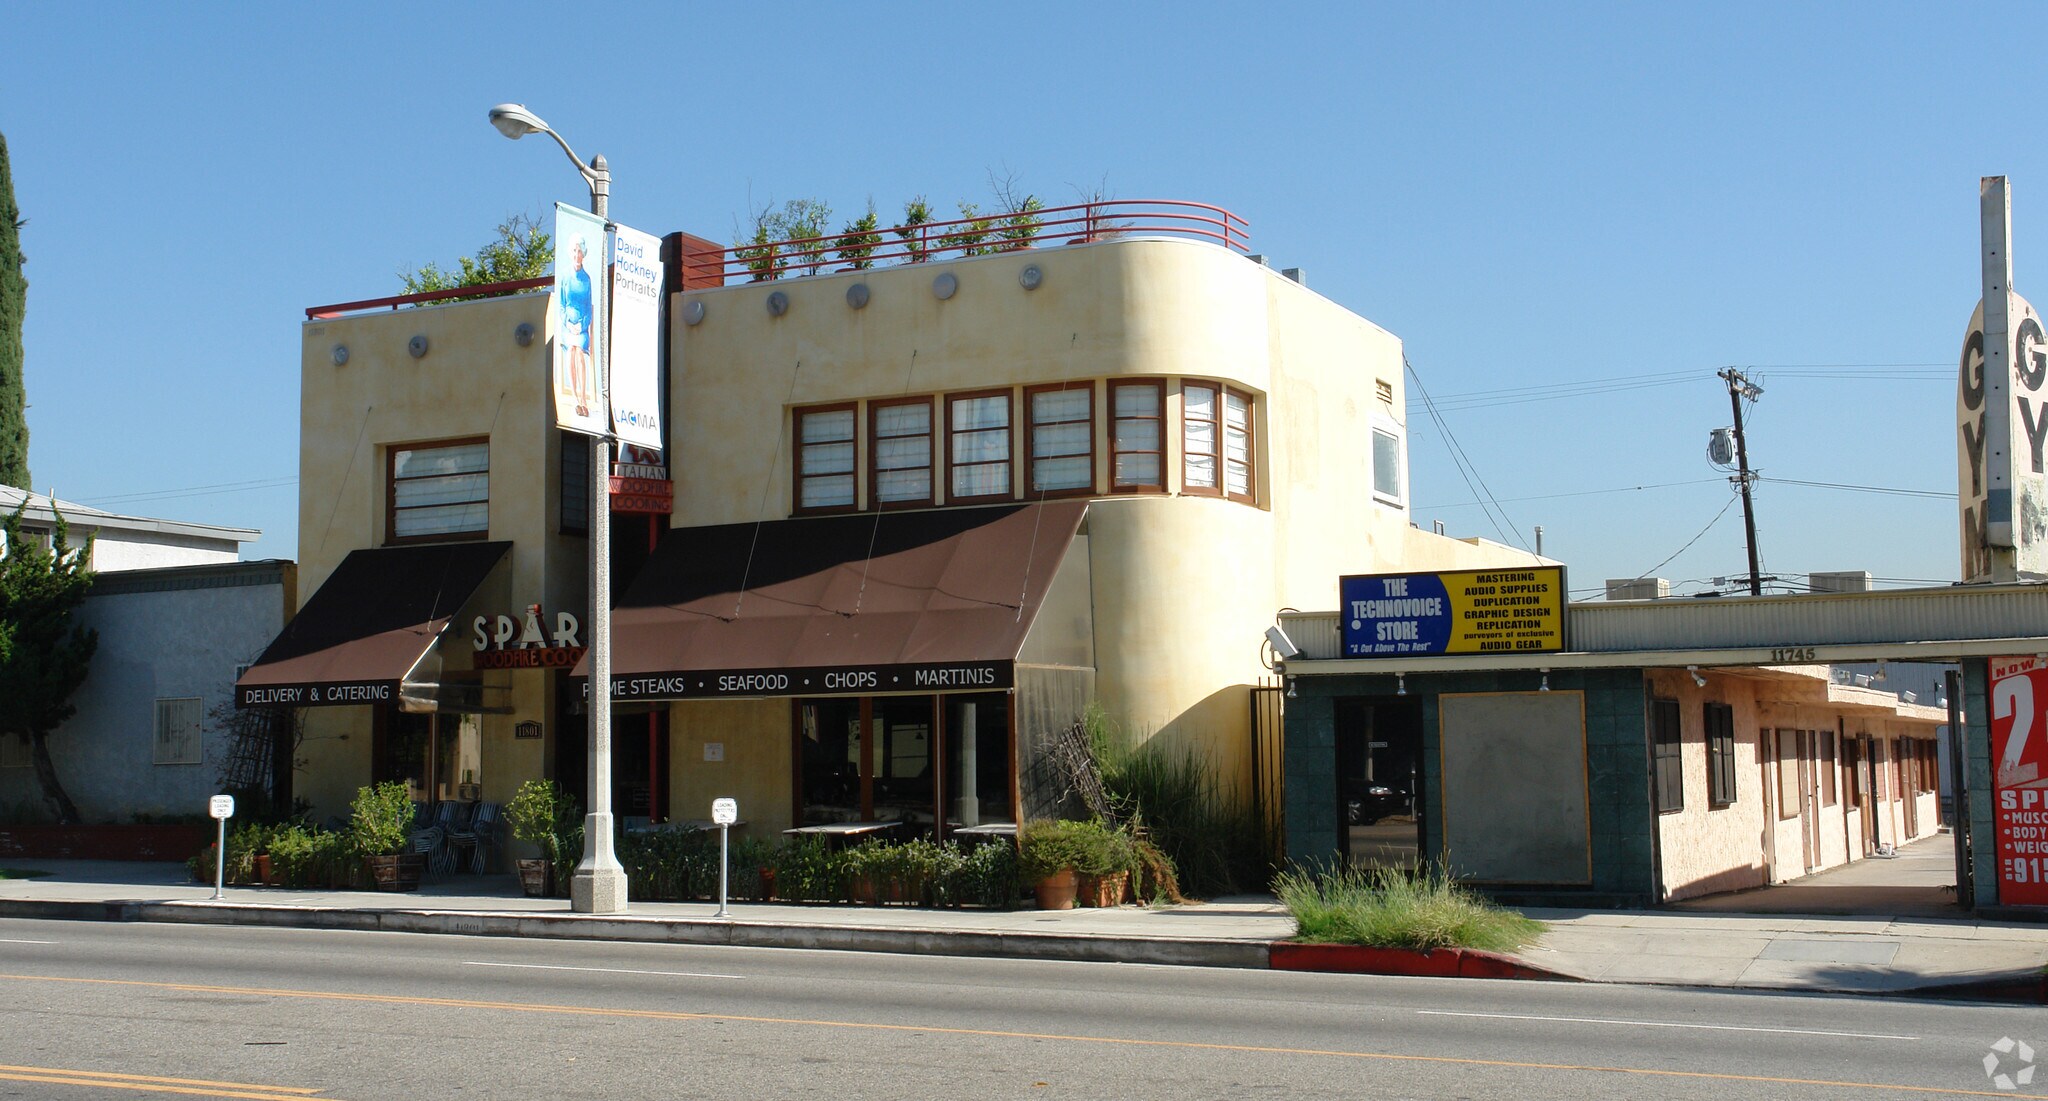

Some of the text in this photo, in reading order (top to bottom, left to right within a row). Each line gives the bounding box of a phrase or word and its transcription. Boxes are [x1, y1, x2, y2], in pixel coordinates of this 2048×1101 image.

[616, 237, 643, 259] David
[616, 244, 657, 283] Hockney
[615, 271, 657, 298] Portraits
[613, 406, 658, 431] LACMA
[1382, 578, 1408, 597] THE
[1476, 573, 1535, 584] MASTERING
[1464, 583, 1548, 596] AUDIO SUPPLIES
[1351, 599, 1442, 619] TECHNOVOICE
[1474, 596, 1540, 607] DUPLICATION
[1464, 608, 1551, 619] GRAPHIC DESIGN
[472, 604, 581, 651] SPAR
[1376, 620, 1419, 641] STORE
[1476, 620, 1541, 630] REPLICATION
[1464, 630, 1554, 640] purveyors of exclusive
[1375, 643, 1395, 652] Above
[1397, 642, 1409, 652] The
[1480, 640, 1542, 650] AUDIO GEAR
[1771, 648, 1816, 662] 11745
[1995, 659, 2035, 677] NOW
[583, 668, 995, 698] PME STEAKS SEAFOOD CHOPS MARTINIS
[246, 685, 389, 704] DELIVERY & CATERING
[518, 725, 539, 737] 11801
[1993, 674, 2048, 790] 2
[2000, 790, 2048, 810] SP
[2013, 827, 2047, 839] BODY
